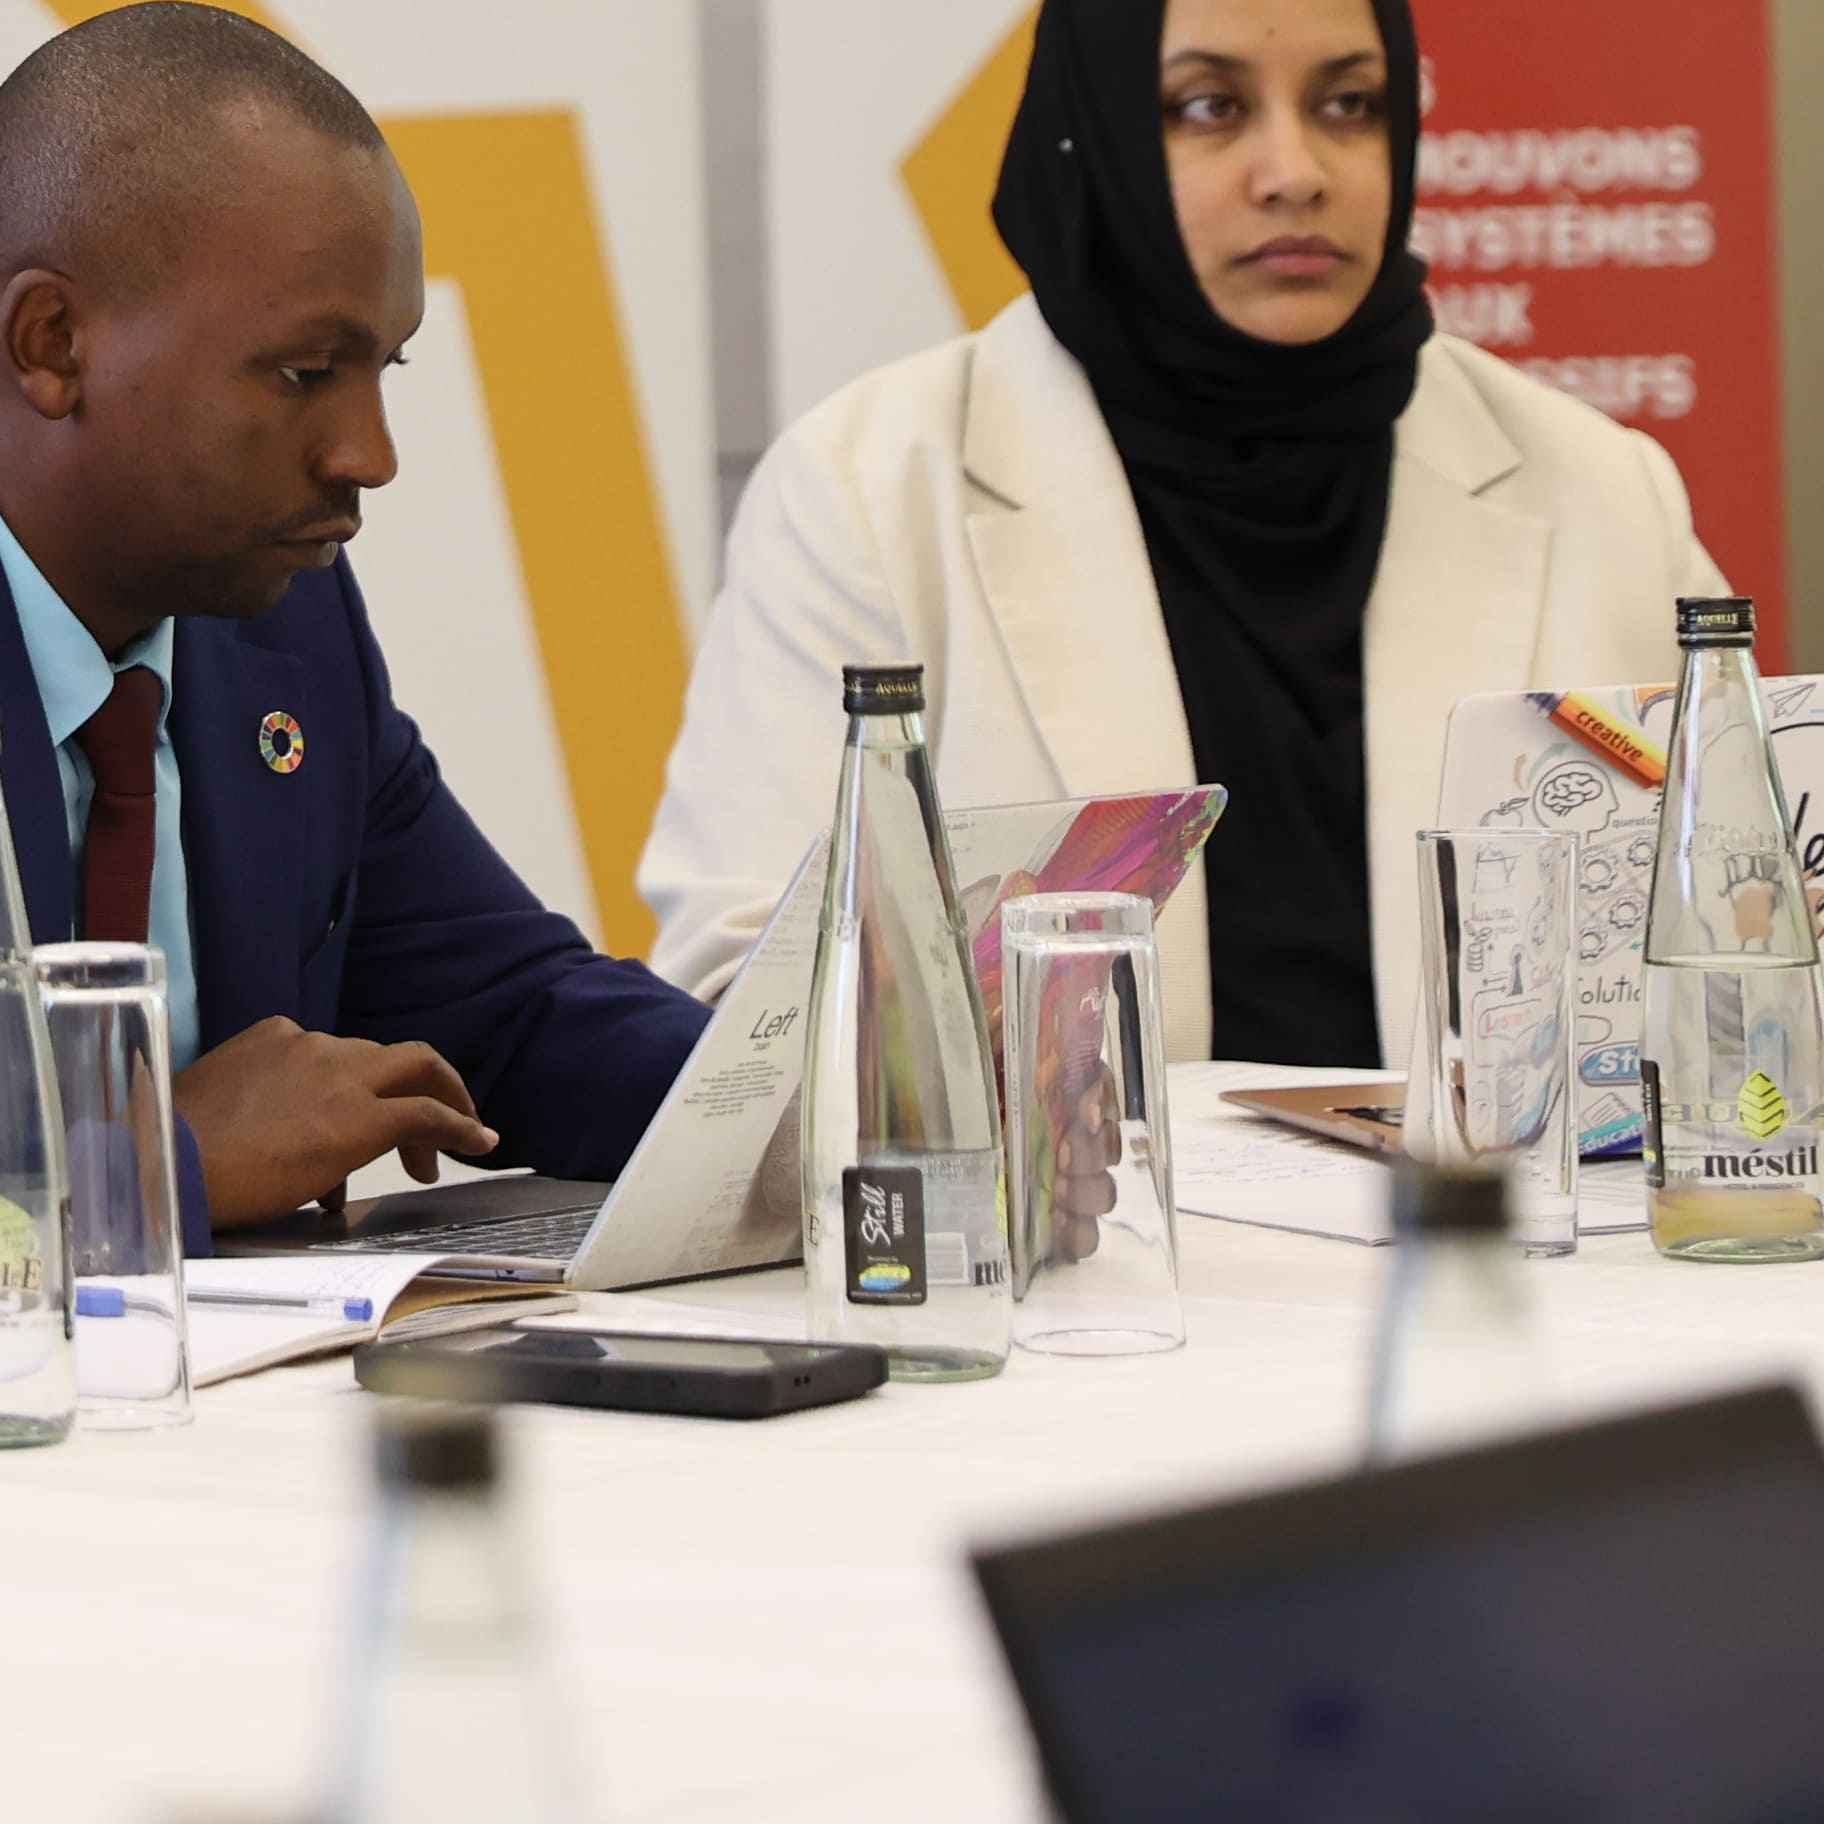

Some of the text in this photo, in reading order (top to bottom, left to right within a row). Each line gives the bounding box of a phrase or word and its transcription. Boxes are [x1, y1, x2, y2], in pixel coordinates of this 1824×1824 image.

[1576, 710, 1643, 761] creative
[1578, 976, 1641, 1004] oluti
[749, 1006, 799, 1039] Left
[1704, 1145, 1819, 1178] méstil
[860, 1181, 892, 1247] Still
[892, 1192, 905, 1236] WATER
